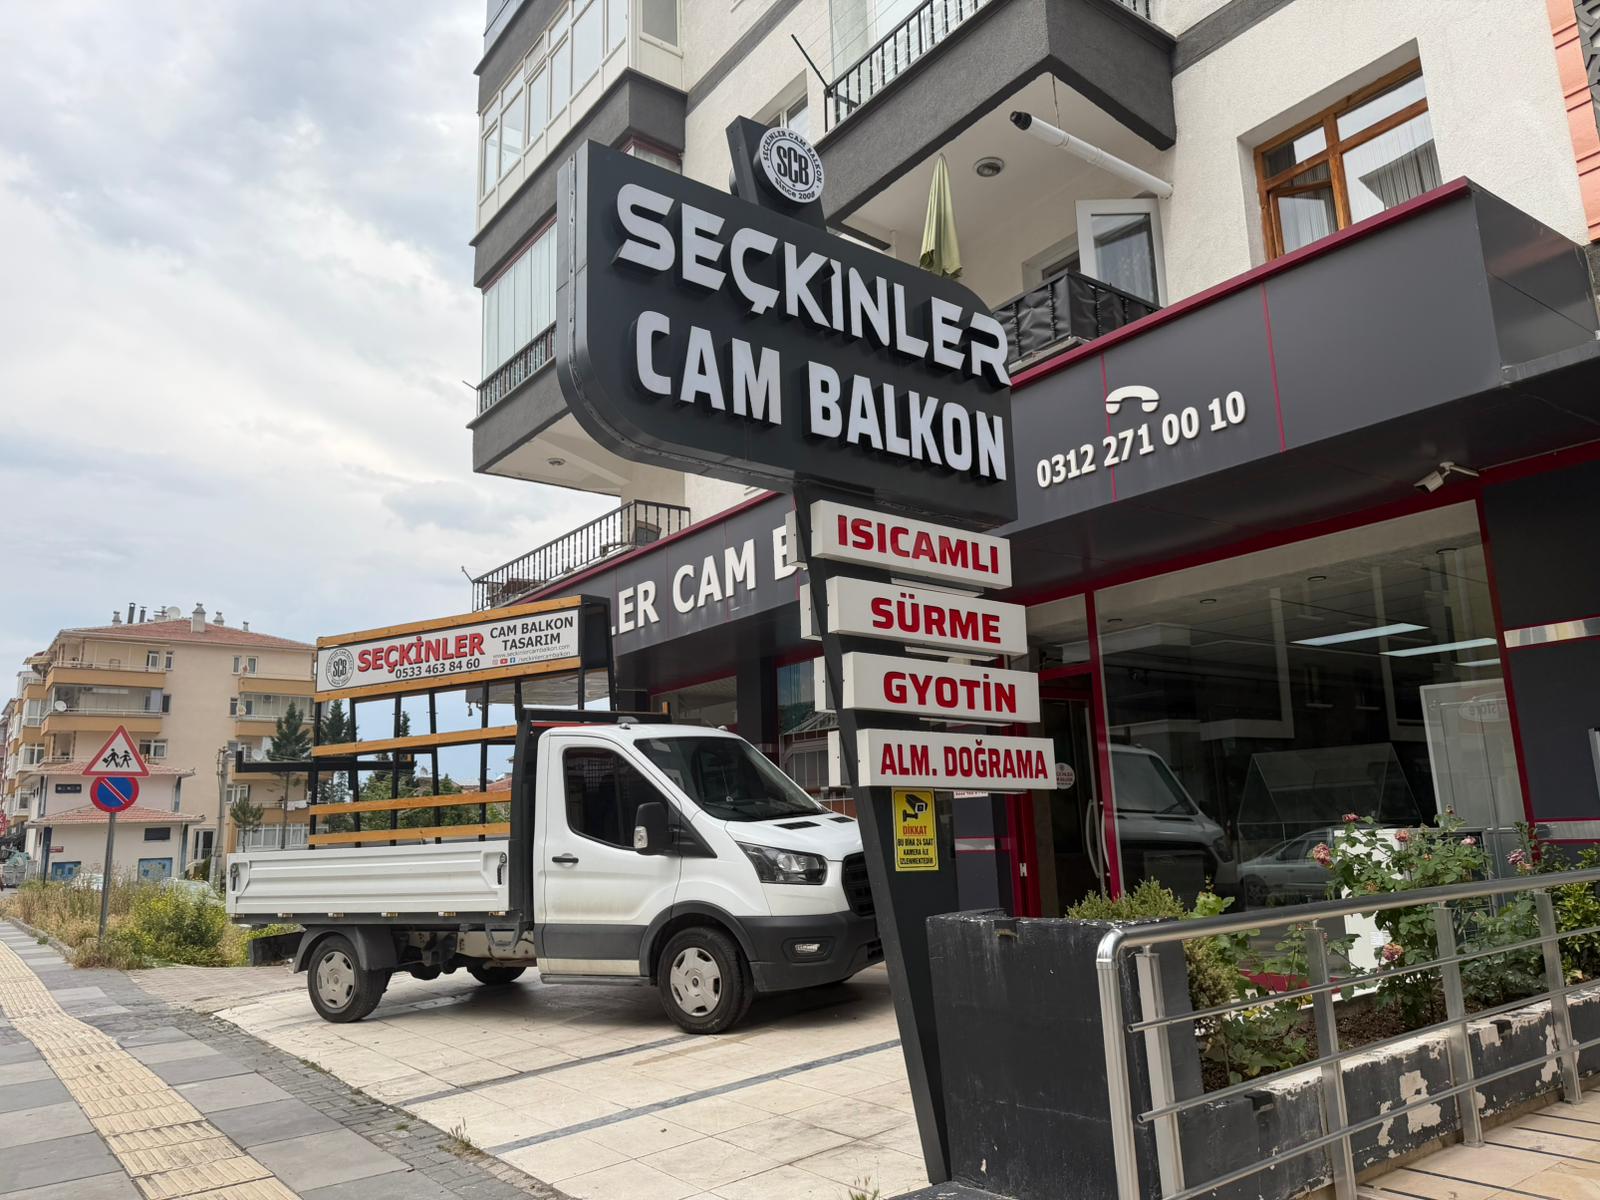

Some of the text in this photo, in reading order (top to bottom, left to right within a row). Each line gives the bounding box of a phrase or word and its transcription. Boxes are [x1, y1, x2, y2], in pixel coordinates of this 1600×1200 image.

[776, 145, 809, 186] SCB
[636, 310, 1007, 482] CAM BALKON
[1036, 390, 1246, 488] 0312 271 00 10
[837, 514, 999, 575] ISICAMLI
[672, 538, 757, 614] CAM
[490, 616, 574, 639] CAM BALKON
[870, 593, 1002, 645] SÜRME
[357, 633, 486, 674] SEÇKİNLER
[502, 632, 561, 651] TASARIM
[332, 657, 348, 678] SCB
[395, 657, 480, 679] 0533 463 84 60
[883, 671, 1017, 714] GYOTİN
[880, 739, 1049, 780] ALM. DOĞRAMA
[903, 824, 927, 835] DİKKAT
